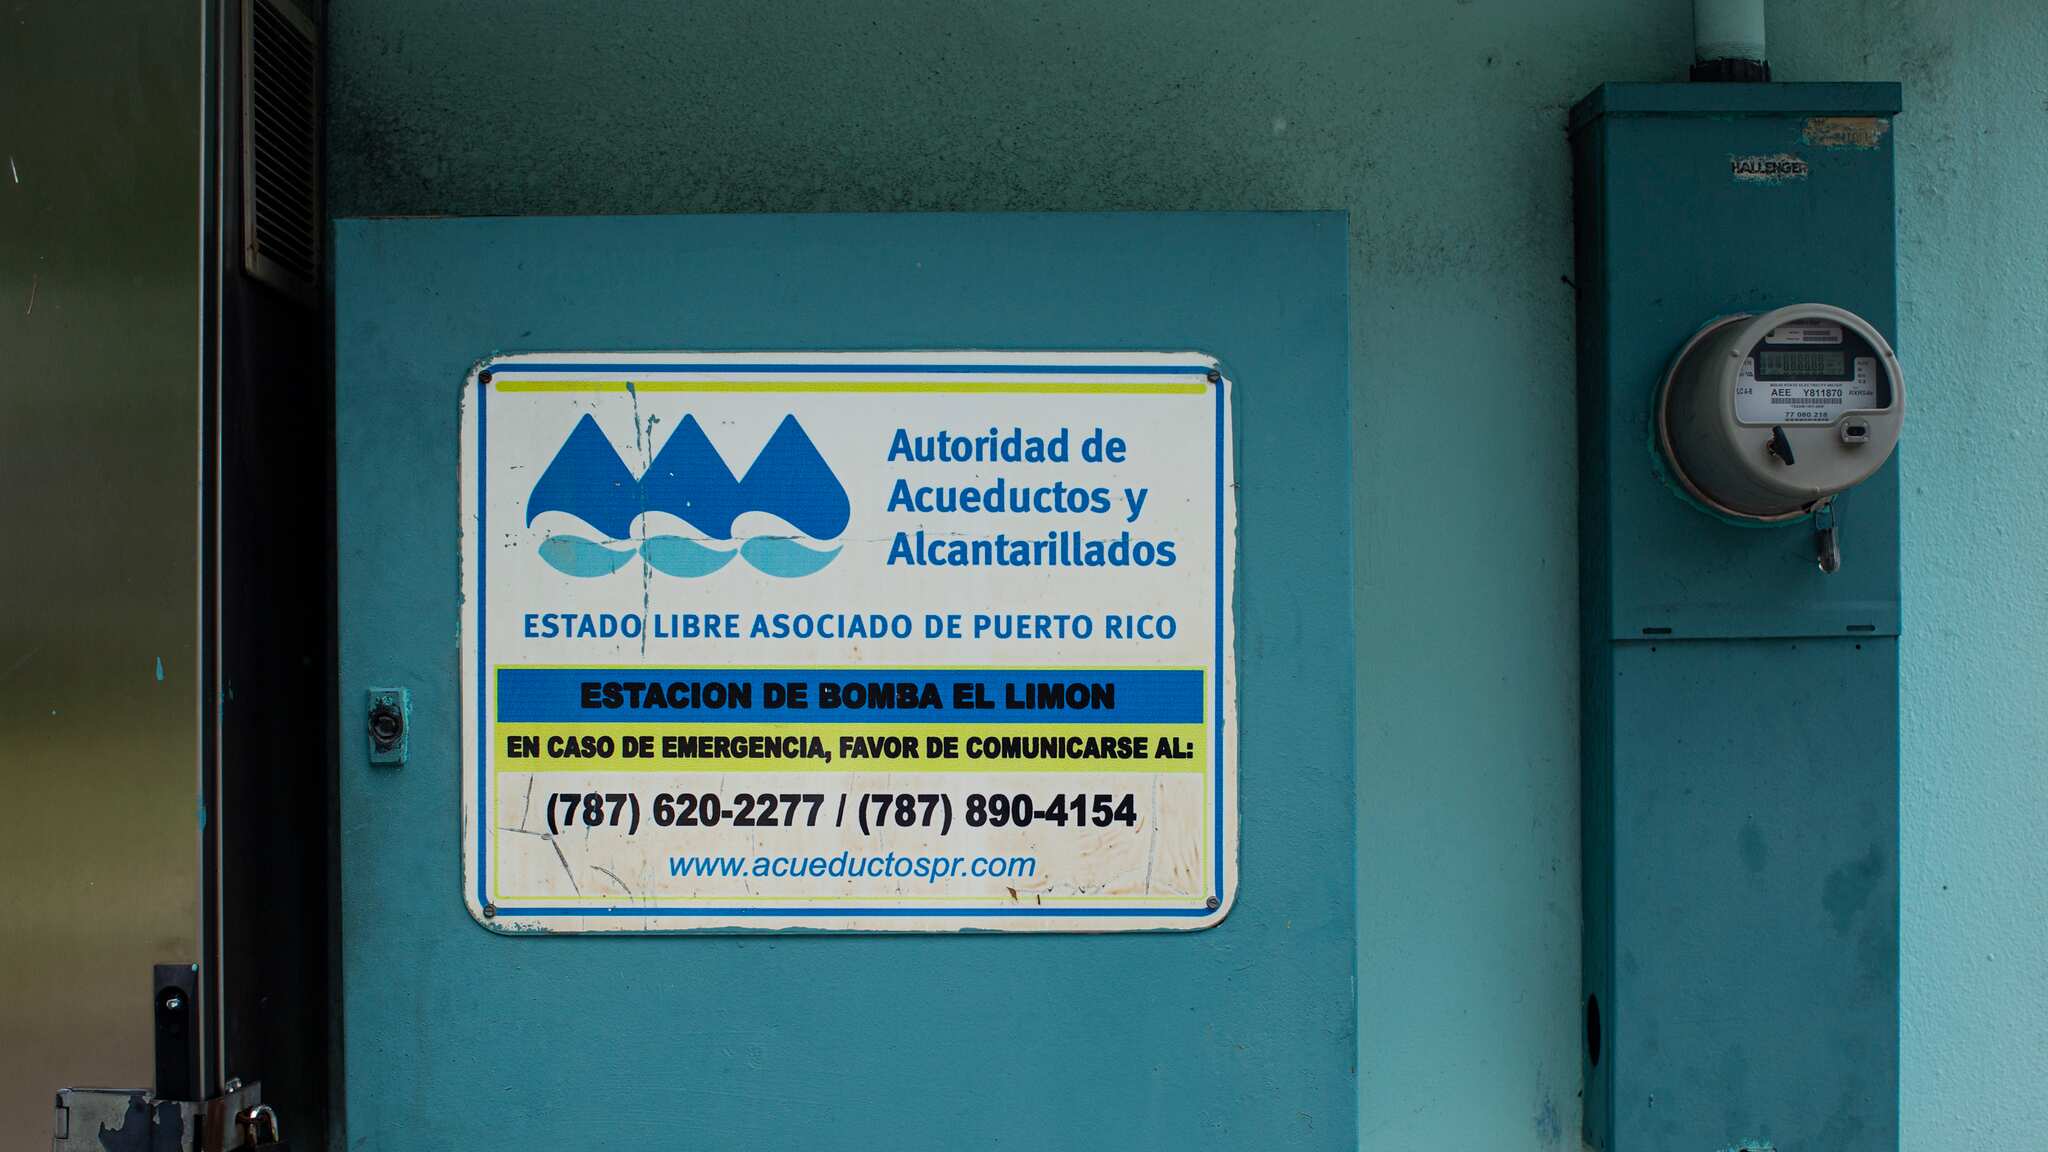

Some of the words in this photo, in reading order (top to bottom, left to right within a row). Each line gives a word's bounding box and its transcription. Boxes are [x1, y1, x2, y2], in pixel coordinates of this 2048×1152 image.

[1771, 388, 1792, 397] AEE
[888, 427, 1068, 463] Autoridad
[1082, 428, 1126, 463] de
[887, 480, 1110, 514] Acueductos
[1126, 488, 1148, 523] y
[887, 531, 1176, 566] Alcantarillados
[525, 614, 642, 639] ESTADO
[655, 614, 739, 638] LIBRE
[750, 614, 912, 638] ASOCIADO
[926, 615, 961, 638] DE
[975, 615, 1092, 639] PUERTO
[1106, 615, 1176, 639] RICO
[581, 682, 751, 708] ESTACION
[764, 683, 808, 708] DE
[819, 683, 943, 709] BOMBA
[954, 683, 994, 709] EL
[1006, 683, 1114, 709] LIMON
[507, 736, 539, 758] EN
[547, 736, 614, 758] CASO
[622, 736, 654, 758] DE
[662, 736, 831, 763] EMERGENCIA,
[840, 737, 919, 758] FAVOR
[927, 737, 958, 758] DE
[967, 737, 1148, 759] COMUNICARSE
[1155, 737, 1193, 758] AL:
[547, 793, 639, 835] (787)
[653, 793, 824, 826] 620-2277
[859, 794, 952, 835] (787)
[966, 794, 1136, 827] 890-4154
[670, 851, 1035, 883] www.acueductospr.com
